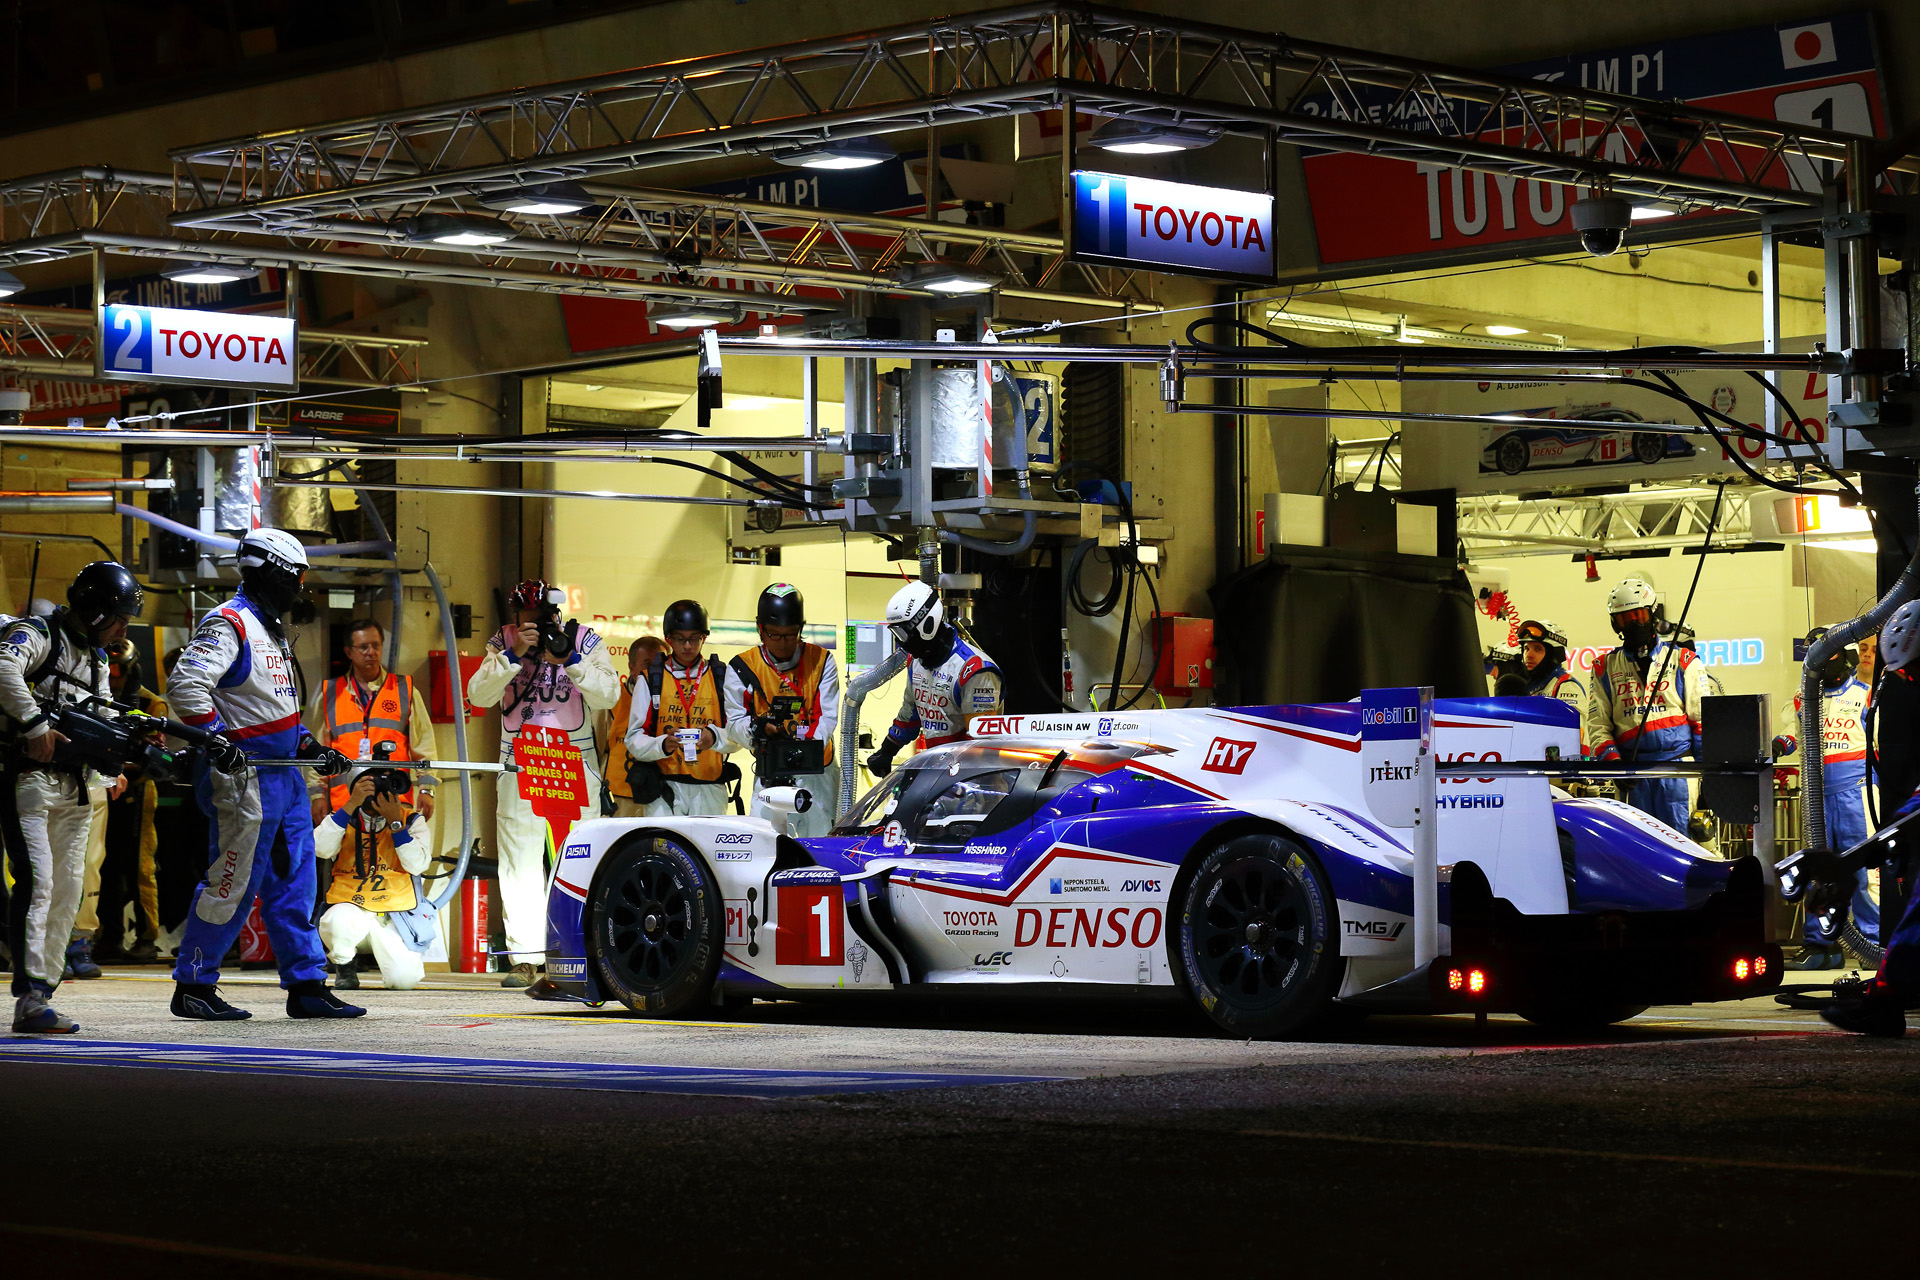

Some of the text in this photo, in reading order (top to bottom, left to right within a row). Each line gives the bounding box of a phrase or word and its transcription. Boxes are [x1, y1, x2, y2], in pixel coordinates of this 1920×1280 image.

[1089, 179, 1267, 254] 1 TOYOTA
[113, 308, 287, 371] 2 TOYOTA
[299, 409, 345, 421] LARBRE
[1024, 386, 1050, 455] 2
[1533, 446, 1563, 457] DENSO
[1604, 441, 1613, 457] 1
[266, 552, 300, 576] uvex
[668, 704, 706, 715] RH TV
[1622, 695, 1667, 708] TOYOTA
[1363, 708, 1402, 725] Mobil
[977, 716, 1025, 735] ZENT
[1045, 723, 1073, 732] AISIN
[1075, 723, 1091, 732] AW
[1113, 722, 1139, 733] zf.com
[540, 727, 549, 748] 1
[523, 744, 582, 761] IGNITION OFF
[1206, 741, 1251, 769] HY
[526, 765, 578, 781] BRAKES ON
[1370, 766, 1413, 784] JTEKT
[529, 786, 576, 801] PIT SPEED
[1435, 794, 1504, 809] HYBRID
[716, 834, 752, 844] RAYS
[565, 846, 590, 858] AISIN
[218, 849, 239, 899] DENSO
[669, 846, 701, 889] MICHELIN
[1306, 877, 1325, 938] MICHELIN
[811, 895, 830, 957] 1
[943, 911, 998, 926] TOYOTA
[972, 928, 999, 937] Racing
[1014, 907, 1162, 948] DENSO
[1343, 920, 1388, 934] TMG
[974, 951, 1013, 966] WEC
[1182, 929, 1199, 987] MICHELIN
[548, 963, 585, 975] MICHELIN
